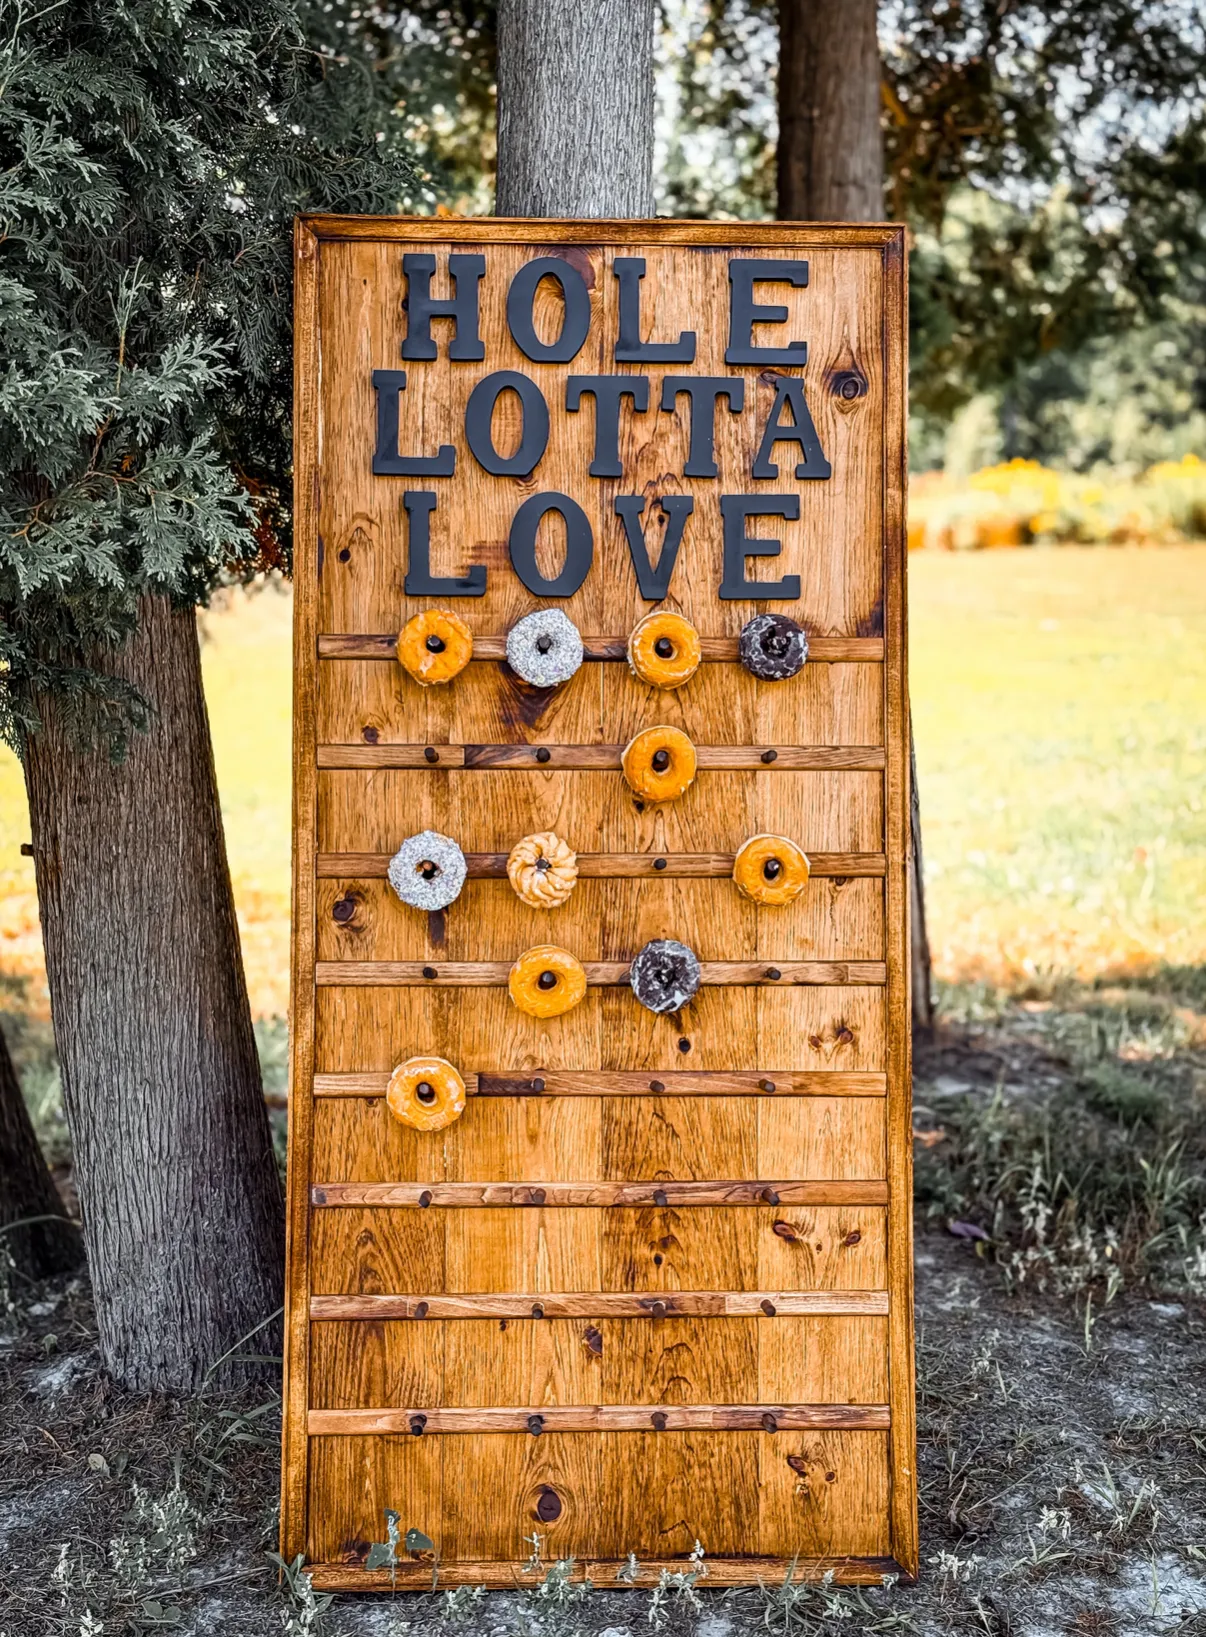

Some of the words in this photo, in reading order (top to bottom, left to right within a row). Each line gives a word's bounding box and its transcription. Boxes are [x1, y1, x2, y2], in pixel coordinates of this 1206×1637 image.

[402, 253, 809, 367] HOLE
[372, 369, 832, 480] LOTTA
[404, 491, 801, 601] LOVE
